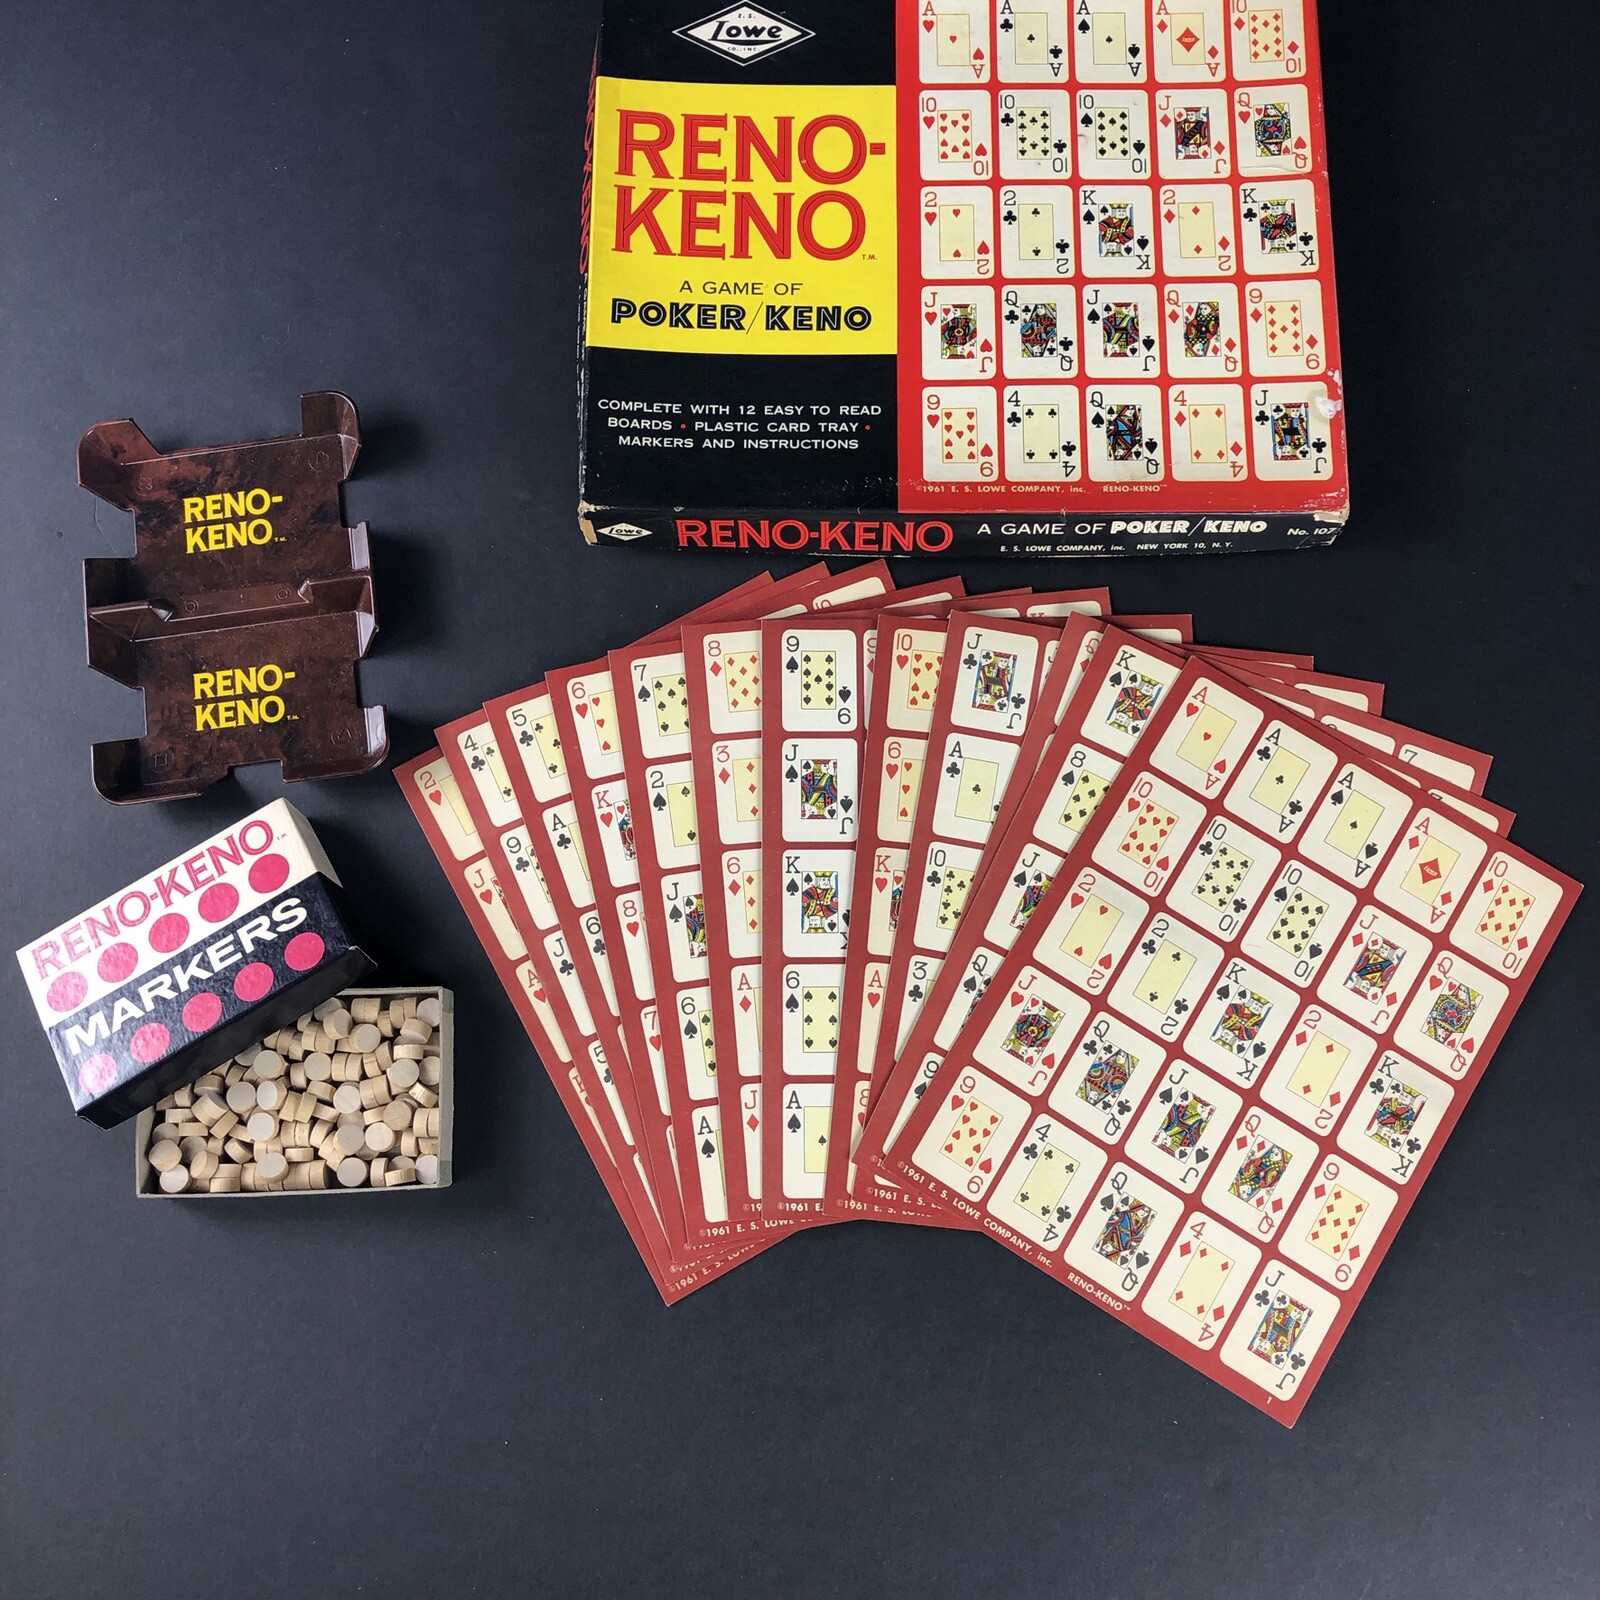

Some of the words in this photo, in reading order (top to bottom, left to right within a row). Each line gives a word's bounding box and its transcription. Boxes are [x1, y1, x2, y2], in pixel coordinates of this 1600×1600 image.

[922, 1, 939, 16] A
[1000, 0, 1016, 17] A
[1076, 0, 1091, 15] A
[1156, 0, 1171, 17] A
[708, 20, 783, 43] Lowe
[922, 97, 937, 112] 10
[1000, 95, 1015, 109] 10
[1079, 95, 1094, 109] 10
[1159, 95, 1171, 110] J
[1237, 92, 1252, 109] Q
[614, 109, 886, 185] RENO-
[925, 192, 937, 207] 2
[1004, 190, 1016, 206] 2
[1082, 190, 1097, 205] K
[1163, 189, 1175, 205] 2
[1241, 188, 1257, 204] K
[611, 184, 866, 261] KENO
[679, 280, 693, 293] A
[702, 281, 764, 295] GAME
[774, 282, 803, 295] OF
[1249, 288, 1262, 304] 9
[925, 292, 938, 308] J
[1004, 291, 1020, 308] Q
[1087, 290, 1100, 305] J
[1166, 290, 1181, 307] Q
[927, 394, 940, 410] 9
[1007, 390, 1021, 407] 4
[1089, 391, 1108, 411] Q
[1174, 390, 1187, 406] 4
[1255, 390, 1268, 406] J
[597, 399, 682, 414] COMPLETE
[690, 404, 730, 415] WITH
[738, 404, 756, 415] 12
[764, 405, 804, 416] EASY
[810, 405, 831, 416] TO
[839, 405, 882, 416] READ
[607, 417, 673, 431] BOARDS
[694, 421, 759, 433] PLASTIC
[766, 422, 810, 433] CARD
[818, 422, 859, 433] TRAY
[618, 435, 694, 448] MARKERS
[702, 438, 735, 449] AND
[743, 438, 859, 450] INSTRUCTIONS
[951, 485, 959, 493] E.
[964, 485, 973, 493] S.
[977, 485, 1007, 493] LOWE
[1010, 485, 1065, 494] COMPANY,
[1069, 485, 1086, 493] inc.
[183, 488, 283, 523] RENO-
[185, 518, 273, 554] KENO
[608, 527, 644, 537] Lowe
[675, 519, 954, 552] RENO-KENO
[977, 523, 992, 535] A
[1000, 522, 1065, 535] GAME
[1074, 523, 1107, 535] OF
[1287, 527, 1309, 536] No.
[1056, 544, 1106, 552] COMPANY,
[1194, 542, 1207, 550] 10,
[708, 640, 721, 657] 8
[786, 636, 799, 652] 9
[897, 633, 912, 651] 10
[967, 633, 983, 649] J
[1116, 650, 1138, 672] K
[634, 664, 647, 681] 7
[193, 664, 296, 700] RENO-
[572, 682, 585, 699] 6
[1192, 686, 1209, 704] A
[194, 695, 285, 731] KENO
[512, 708, 527, 726] 5
[464, 734, 479, 751] 4
[1265, 728, 1281, 746] A
[716, 745, 730, 763] 3
[785, 744, 799, 761] J
[948, 741, 963, 758] A
[1070, 751, 1086, 768] 8
[420, 771, 436, 789] 2
[650, 771, 664, 789] 2
[1133, 778, 1153, 798] 10
[1337, 771, 1354, 790] A
[595, 790, 612, 809] K
[552, 813, 567, 831] A
[1207, 819, 1227, 840] 10
[1415, 817, 1430, 835] A
[785, 856, 803, 876] K
[929, 848, 946, 867] 10
[1022, 852, 1040, 868] J
[1282, 864, 1302, 885] 10
[1489, 857, 1508, 877] 10
[1078, 874, 1096, 893] 2
[31, 820, 274, 981] RENO-KENO
[1151, 919, 1169, 938] 2
[1360, 914, 1378, 929] J
[1225, 962, 1247, 985] K
[1437, 957, 1453, 979] Q
[64, 898, 308, 1056] MARKERS
[786, 971, 800, 989] 6
[1018, 974, 1037, 990] J
[1303, 1010, 1321, 1029] 2
[1093, 1020, 1112, 1045] Q
[1378, 1055, 1399, 1078] K
[960, 1076, 976, 1093] 9
[1169, 1069, 1189, 1084] J
[786, 1090, 802, 1109] A
[1035, 1124, 1051, 1142] 4
[1245, 1114, 1261, 1138] Q
[1323, 1163, 1339, 1180] 9
[1111, 1172, 1128, 1196] Q
[815, 1202, 823, 1211] E.
[903, 1194, 912, 1203] E.
[736, 1224, 745, 1233] E.
[750, 1221, 760, 1231] S.
[928, 1182, 936, 1193] E.
[940, 1190, 948, 1200] S.
[952, 1198, 981, 1221] LOWE
[983, 1218, 1033, 1256] COMPANY,
[1036, 1252, 1053, 1268] inc.
[1190, 1222, 1206, 1240] 4
[1265, 1270, 1285, 1287] J
